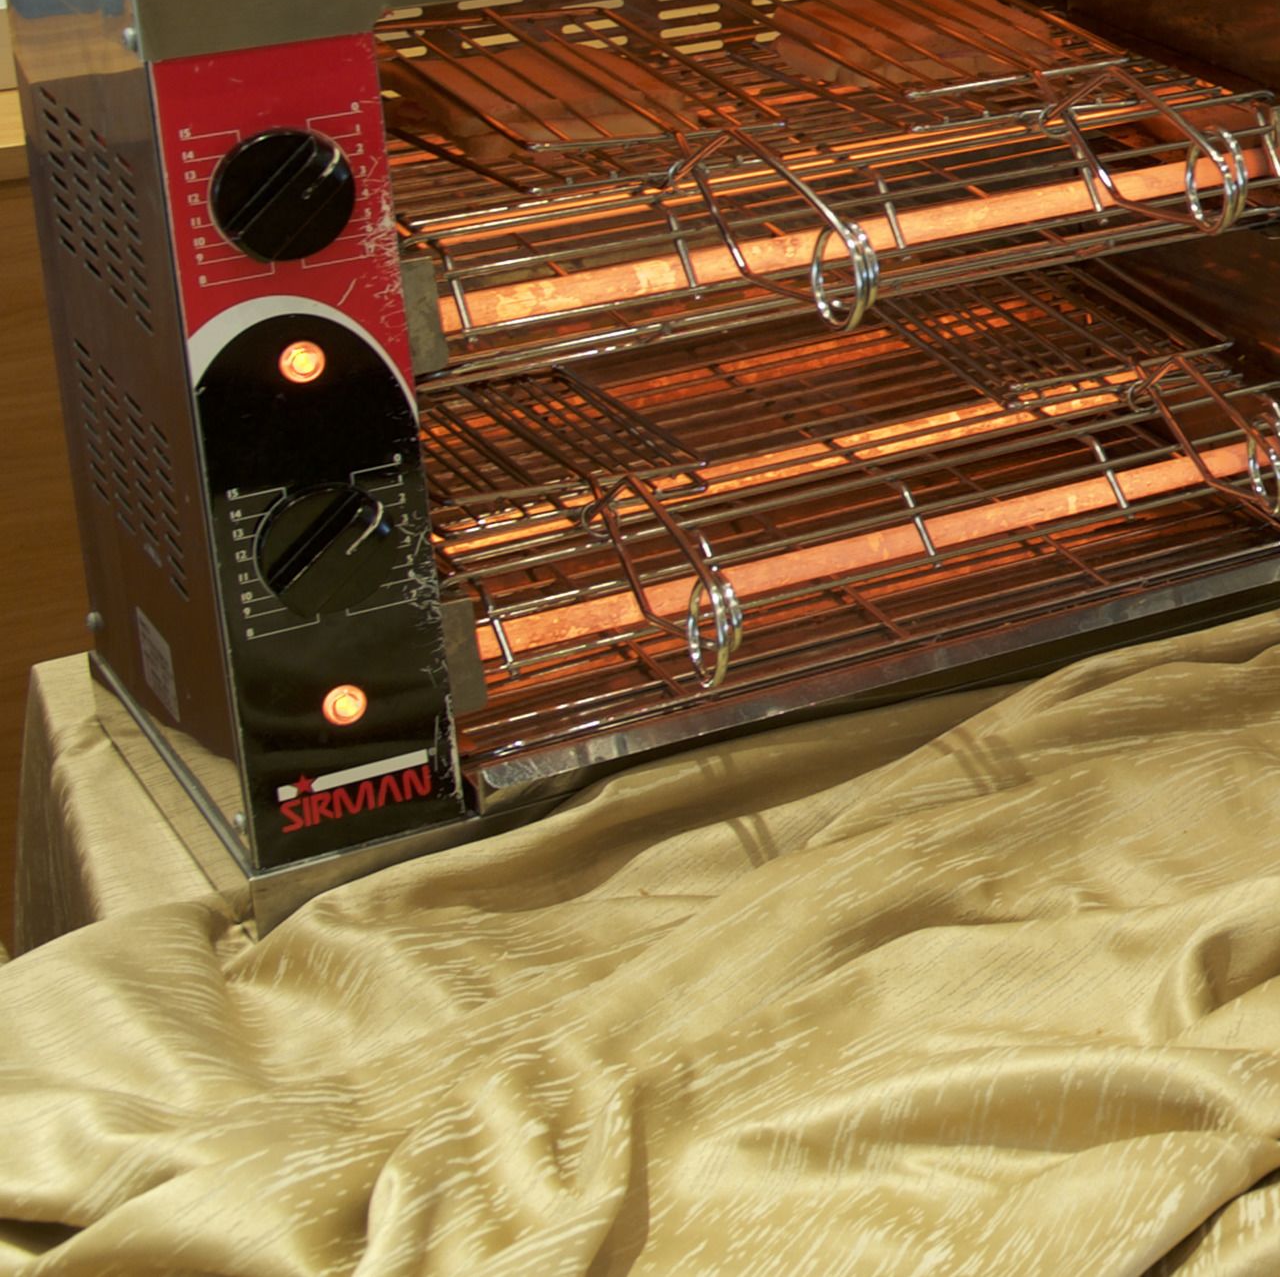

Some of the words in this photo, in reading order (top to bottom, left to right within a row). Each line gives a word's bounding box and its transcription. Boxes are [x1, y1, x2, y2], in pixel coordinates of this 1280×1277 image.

[179, 128, 191, 139] 15
[356, 143, 364, 153] 2
[182, 151, 194, 162] 14
[184, 170, 196, 181] 13
[361, 188, 369, 197] 4
[188, 193, 200, 204] 12
[191, 218, 201, 227] 11
[193, 237, 205, 247] 10
[196, 254, 204, 263] 9
[226, 488, 239, 499] 15
[399, 493, 406, 502] 2
[229, 509, 242, 520] 14
[232, 529, 244, 539] 13
[235, 550, 247, 560] 12
[238, 573, 248, 583] 11
[241, 591, 253, 602] 10
[243, 607, 250, 617] 9
[280, 765, 432, 834] SIRMAN
